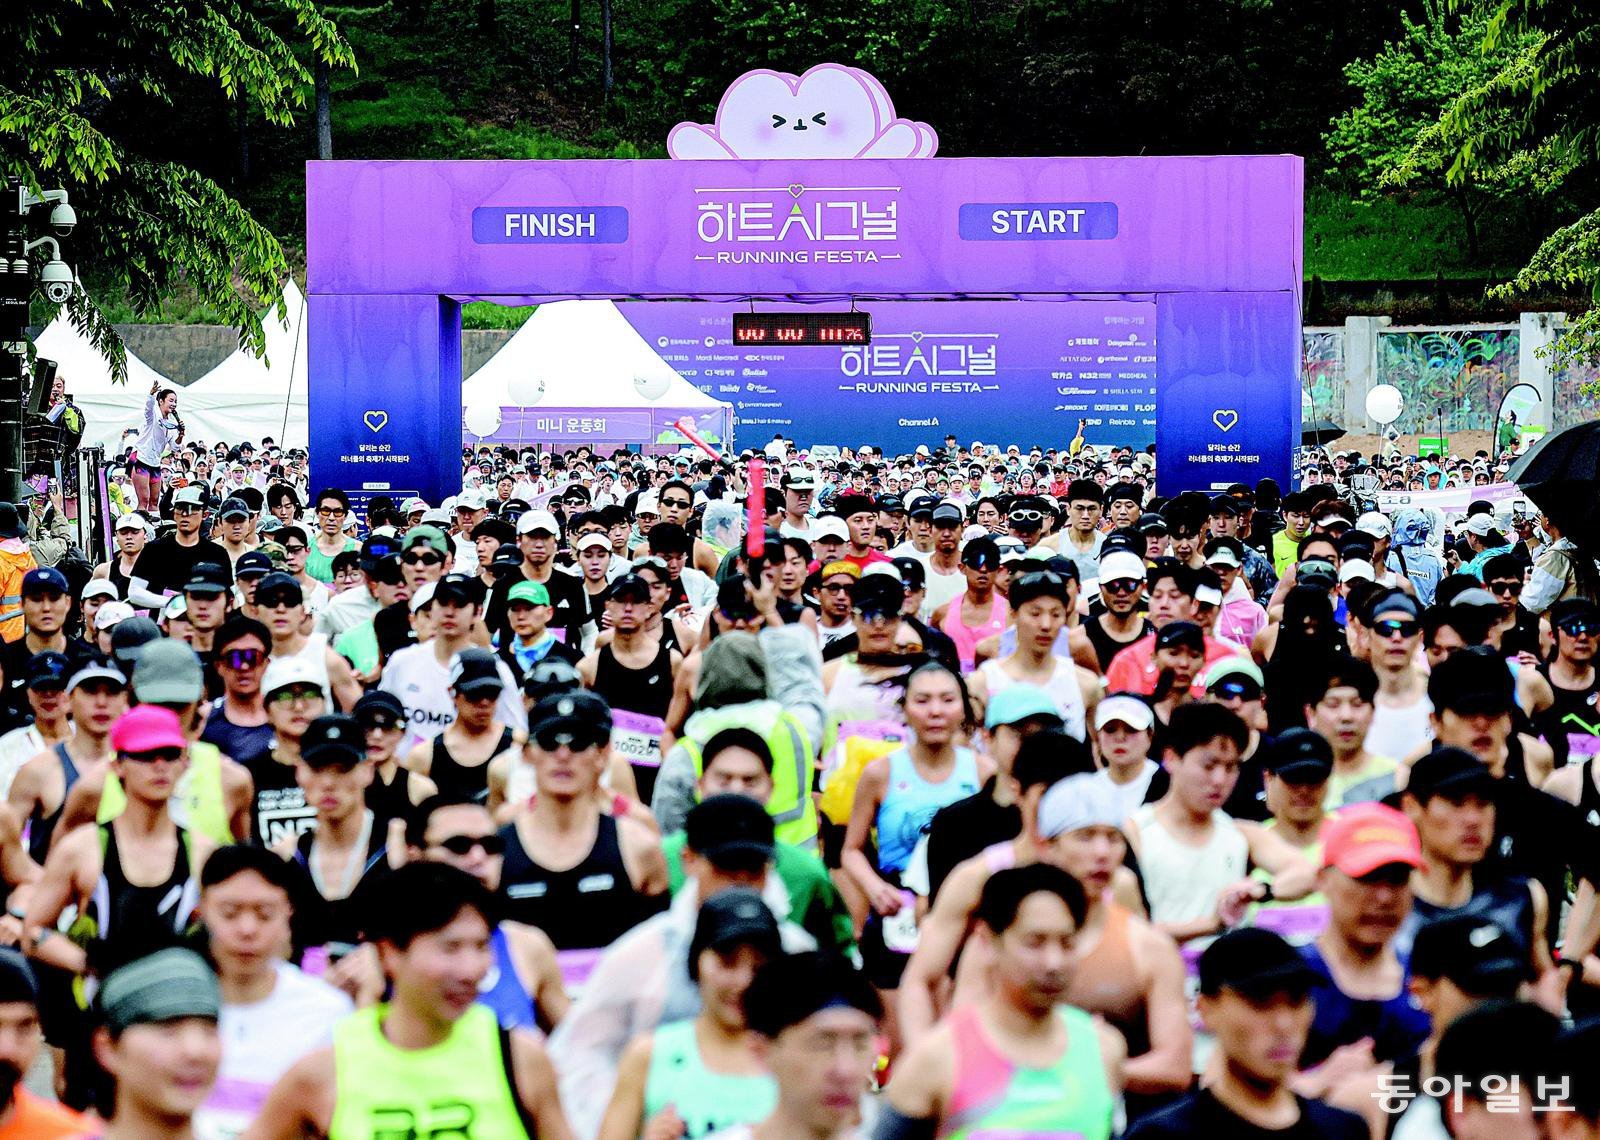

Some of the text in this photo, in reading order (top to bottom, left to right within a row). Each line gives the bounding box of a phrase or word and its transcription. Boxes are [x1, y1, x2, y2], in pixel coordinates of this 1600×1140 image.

[505, 213, 595, 237] FINISH
[697, 201, 897, 243] 하트시그널
[991, 209, 1086, 234] START
[717, 250, 879, 264] RUNNING FESTA
[840, 345, 996, 377] 하트시그널
[856, 382, 982, 393] RUNNING FESTA
[536, 417, 607, 434] 미니 운동회
[359, 444, 391, 452] 달리는 순간
[1207, 444, 1241, 452] 달리는 순간
